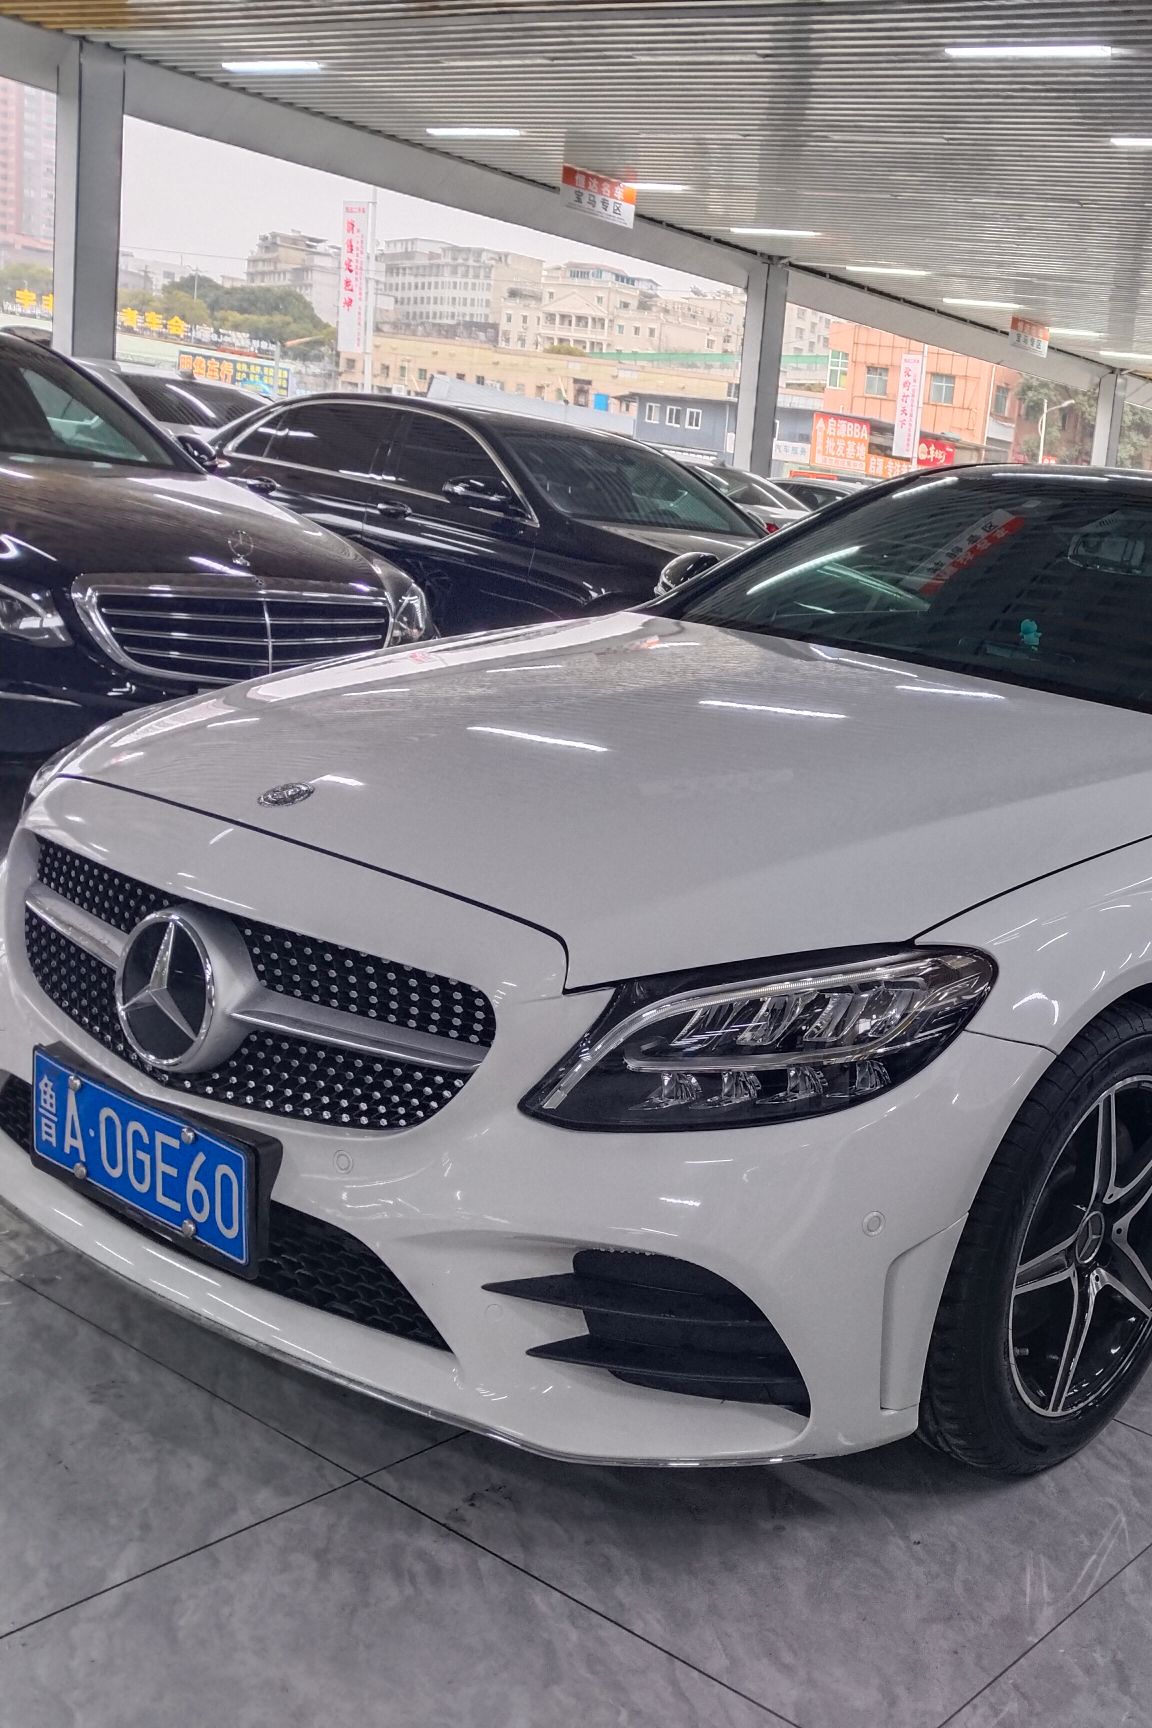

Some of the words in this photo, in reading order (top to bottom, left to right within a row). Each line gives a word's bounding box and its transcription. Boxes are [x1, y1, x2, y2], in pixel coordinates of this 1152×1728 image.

[574, 190, 622, 216] 宝马专区
[827, 417, 868, 440] 启源BBA
[825, 437, 866, 460] 批发基地
